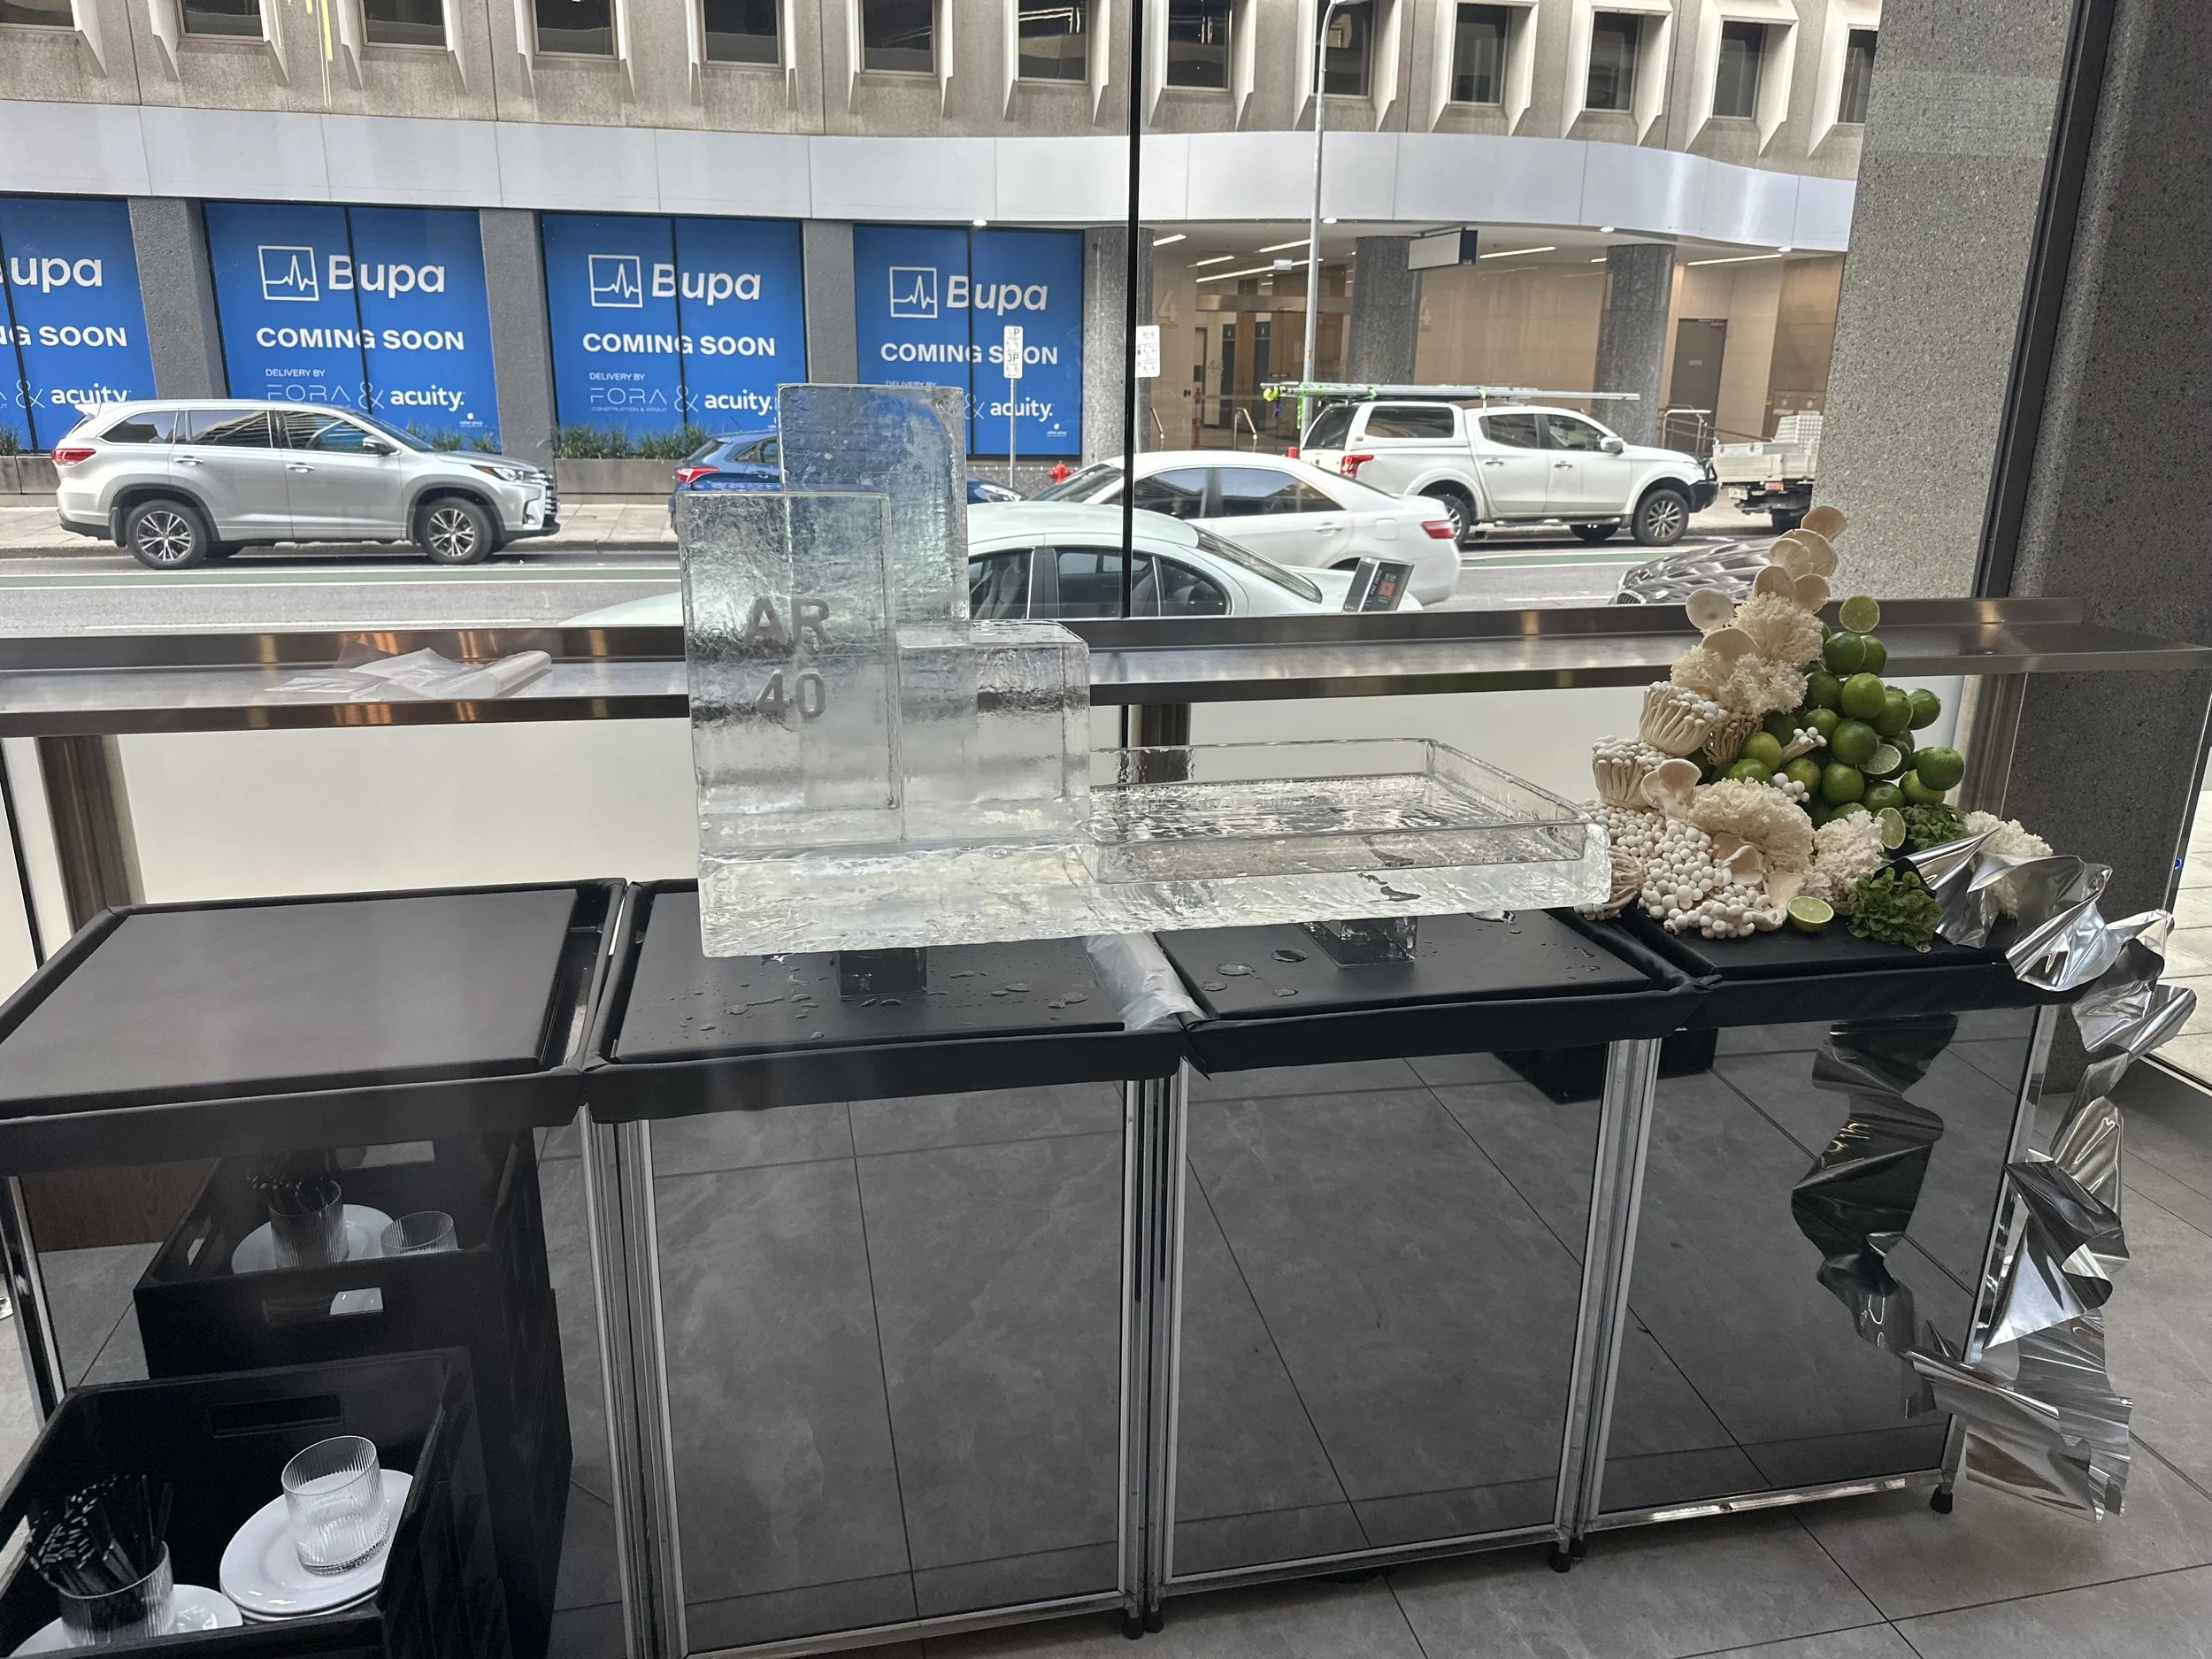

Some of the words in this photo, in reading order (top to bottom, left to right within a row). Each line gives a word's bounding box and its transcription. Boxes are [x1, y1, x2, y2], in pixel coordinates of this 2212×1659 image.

[0, 257, 103, 293] upa
[328, 255, 445, 298] Bupa
[652, 263, 761, 306] Bupa
[947, 275, 1048, 316] Bupa
[39, 326, 127, 346] SOON
[256, 327, 376, 349] COMING
[382, 329, 465, 350] SOON
[582, 333, 693, 354] COMING
[700, 335, 775, 356] SOON
[880, 342, 982, 364] COMING
[988, 346, 1057, 365] SON
[1007, 353, 1019, 363] 3P
[265, 368, 311, 377] DELIVERY
[266, 384, 351, 402] FORA
[357, 381, 385, 409] &
[590, 388, 668, 404] FORA
[674, 385, 699, 412] &
[743, 597, 833, 646] AR
[756, 671, 826, 718] 40
